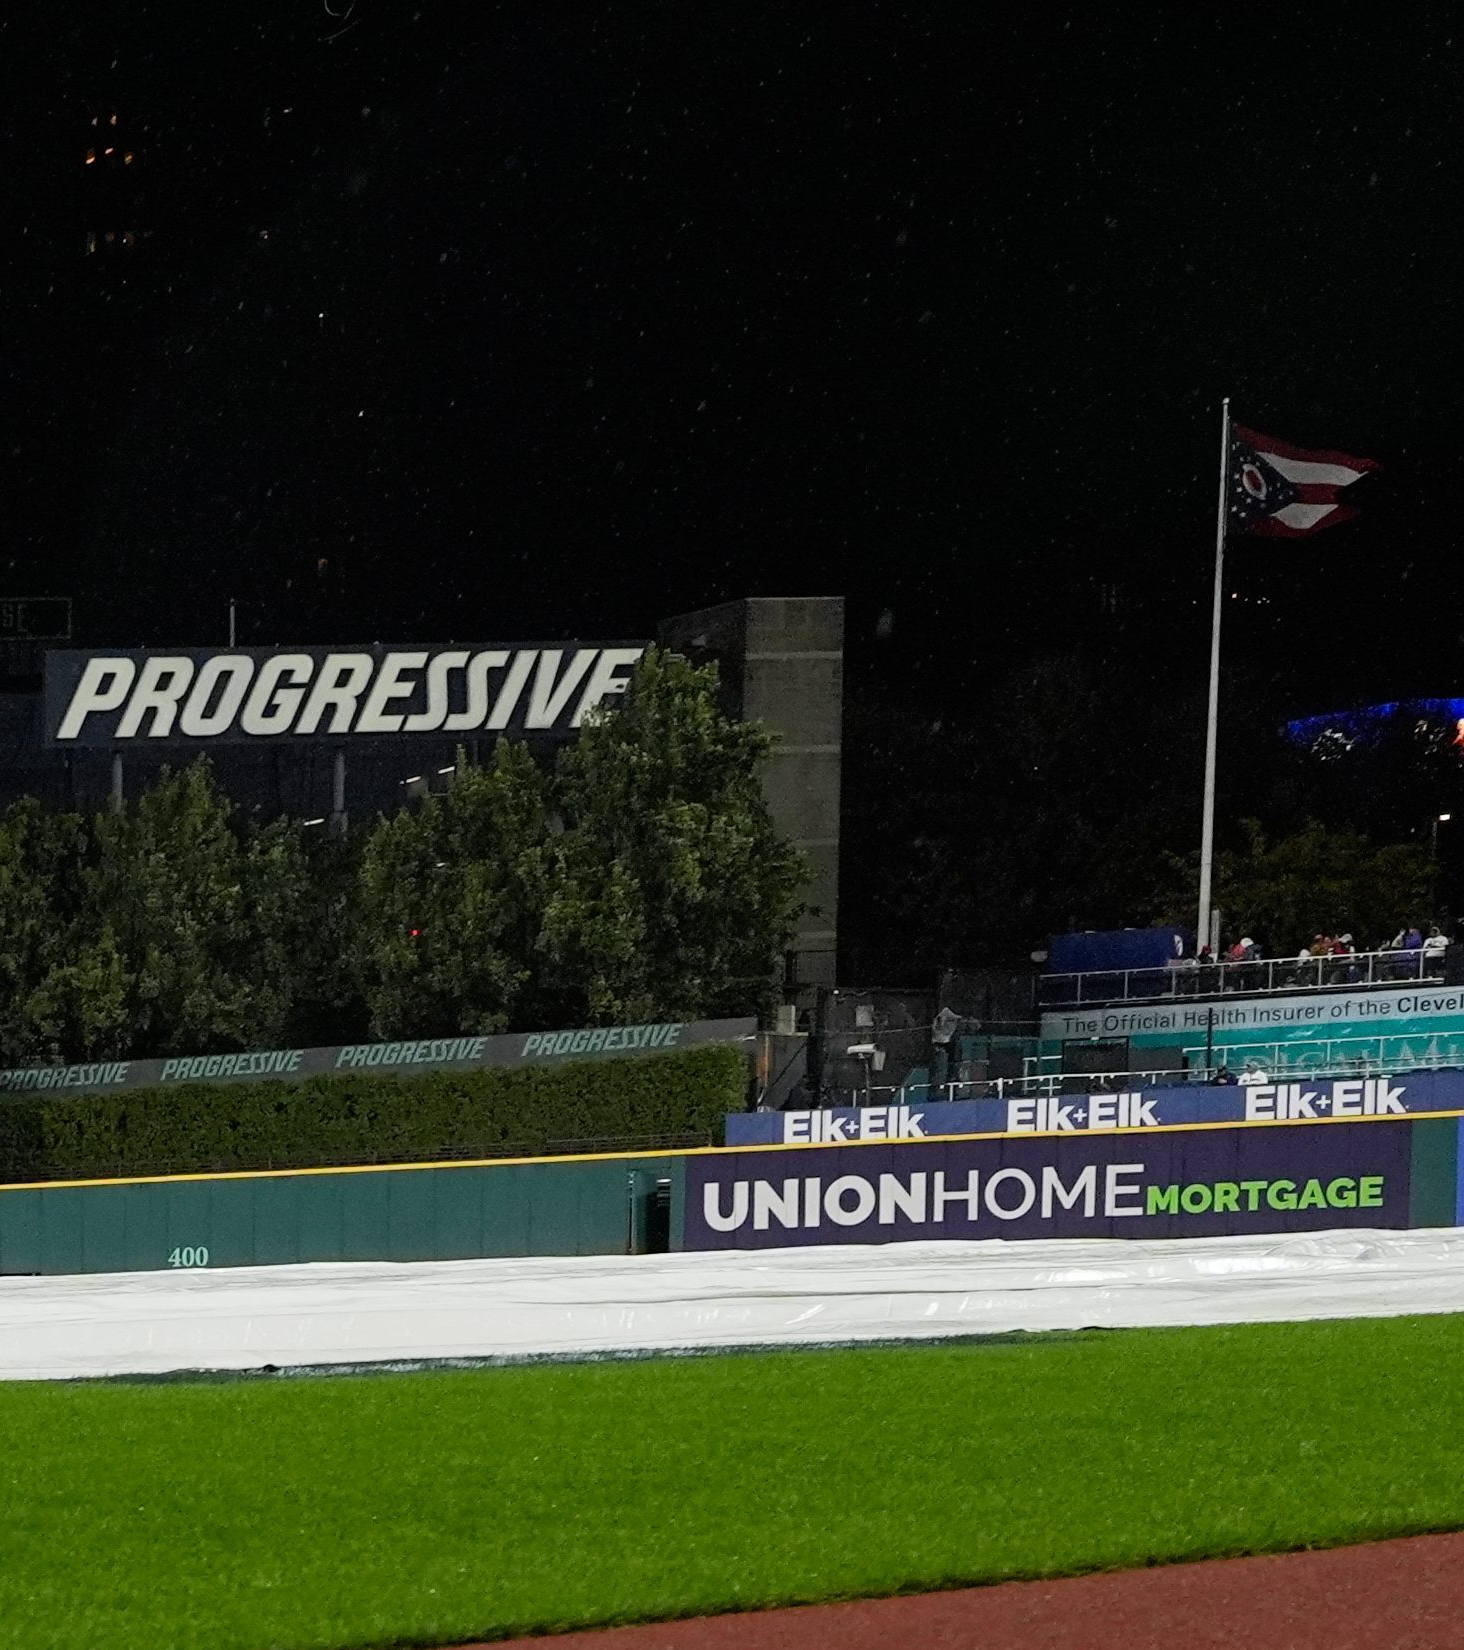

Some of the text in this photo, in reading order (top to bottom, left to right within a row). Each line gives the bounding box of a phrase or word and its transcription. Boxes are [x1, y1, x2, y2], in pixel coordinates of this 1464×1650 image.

[57, 648, 645, 739] PROGRESSIVE
[1063, 1016, 1097, 1033] The
[1101, 1011, 1175, 1031] Official
[1184, 1007, 1246, 1027] Health
[1253, 1003, 1324, 1023] Insurer
[1331, 1000, 1354, 1018] of
[1358, 999, 1391, 1016] the
[336, 1037, 487, 1068] PROGRESSIVE
[521, 1024, 684, 1058] PROGRESSIVE
[160, 1050, 304, 1081] PROGRESSIVE
[1006, 1091, 1158, 1132] Elk+Elk
[1244, 1078, 1407, 1122] Elk+Elk
[783, 1105, 924, 1144] Elk+Elk
[1146, 1176, 1384, 1215] MORTGAGE
[168, 1246, 208, 1268] 400
